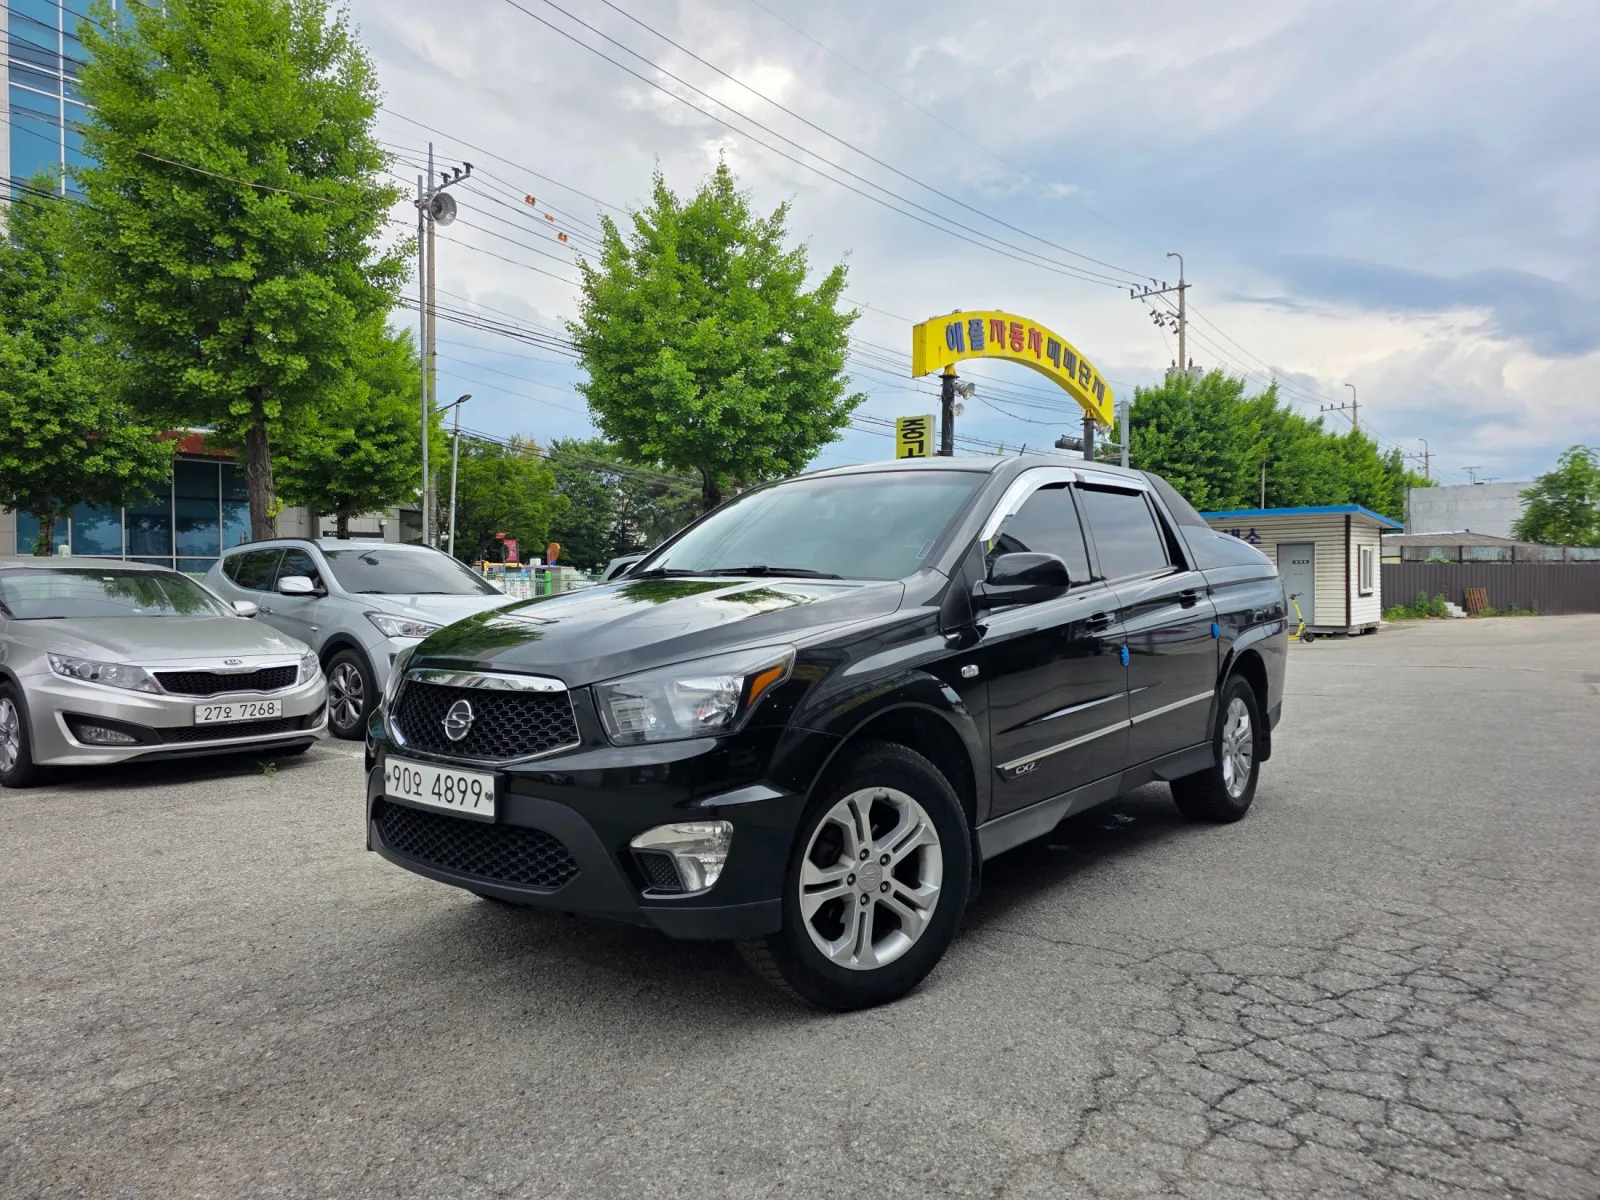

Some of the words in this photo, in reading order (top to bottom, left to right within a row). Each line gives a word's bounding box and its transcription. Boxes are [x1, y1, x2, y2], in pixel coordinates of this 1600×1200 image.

[946, 318, 985, 353] 애플
[989, 318, 1043, 359] 자동차
[1046, 336, 1106, 407] 매매단지
[900, 418, 926, 459] 중고
[204, 706, 232, 720] 27오
[240, 702, 275, 718] 7268
[393, 765, 422, 796] 90오
[431, 773, 482, 808] 4899
